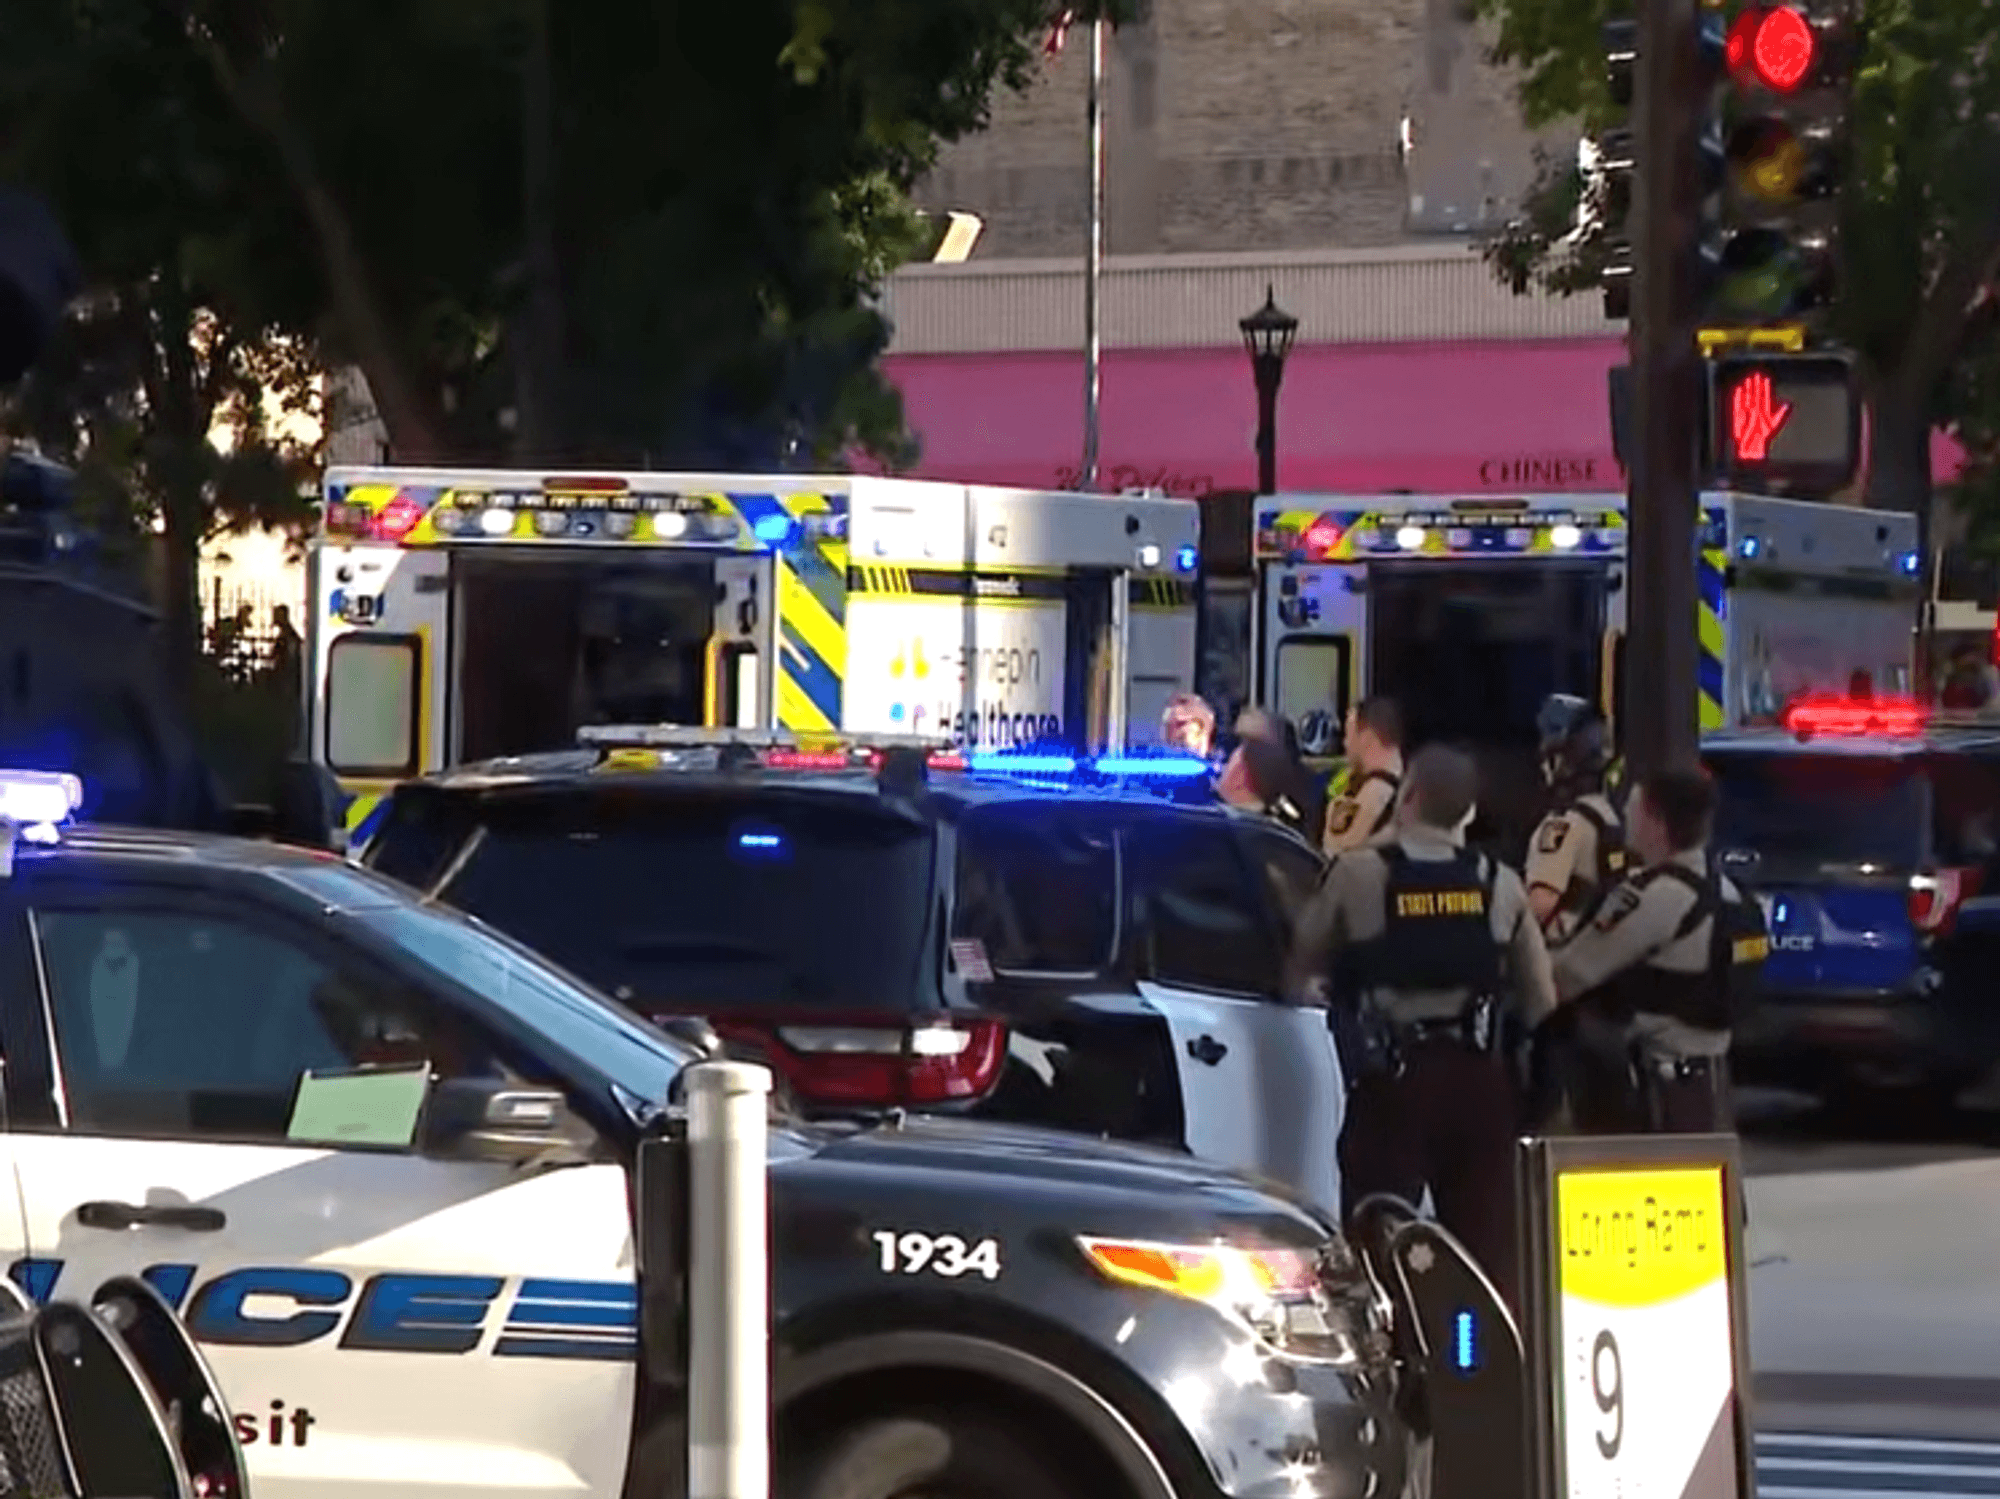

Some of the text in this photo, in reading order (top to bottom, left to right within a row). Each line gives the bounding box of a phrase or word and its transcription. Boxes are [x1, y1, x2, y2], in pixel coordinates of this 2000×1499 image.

[1479, 458, 1597, 486] CHINESE
[872, 1230, 1001, 1280] 1934
[1591, 1328, 1624, 1460] 9
